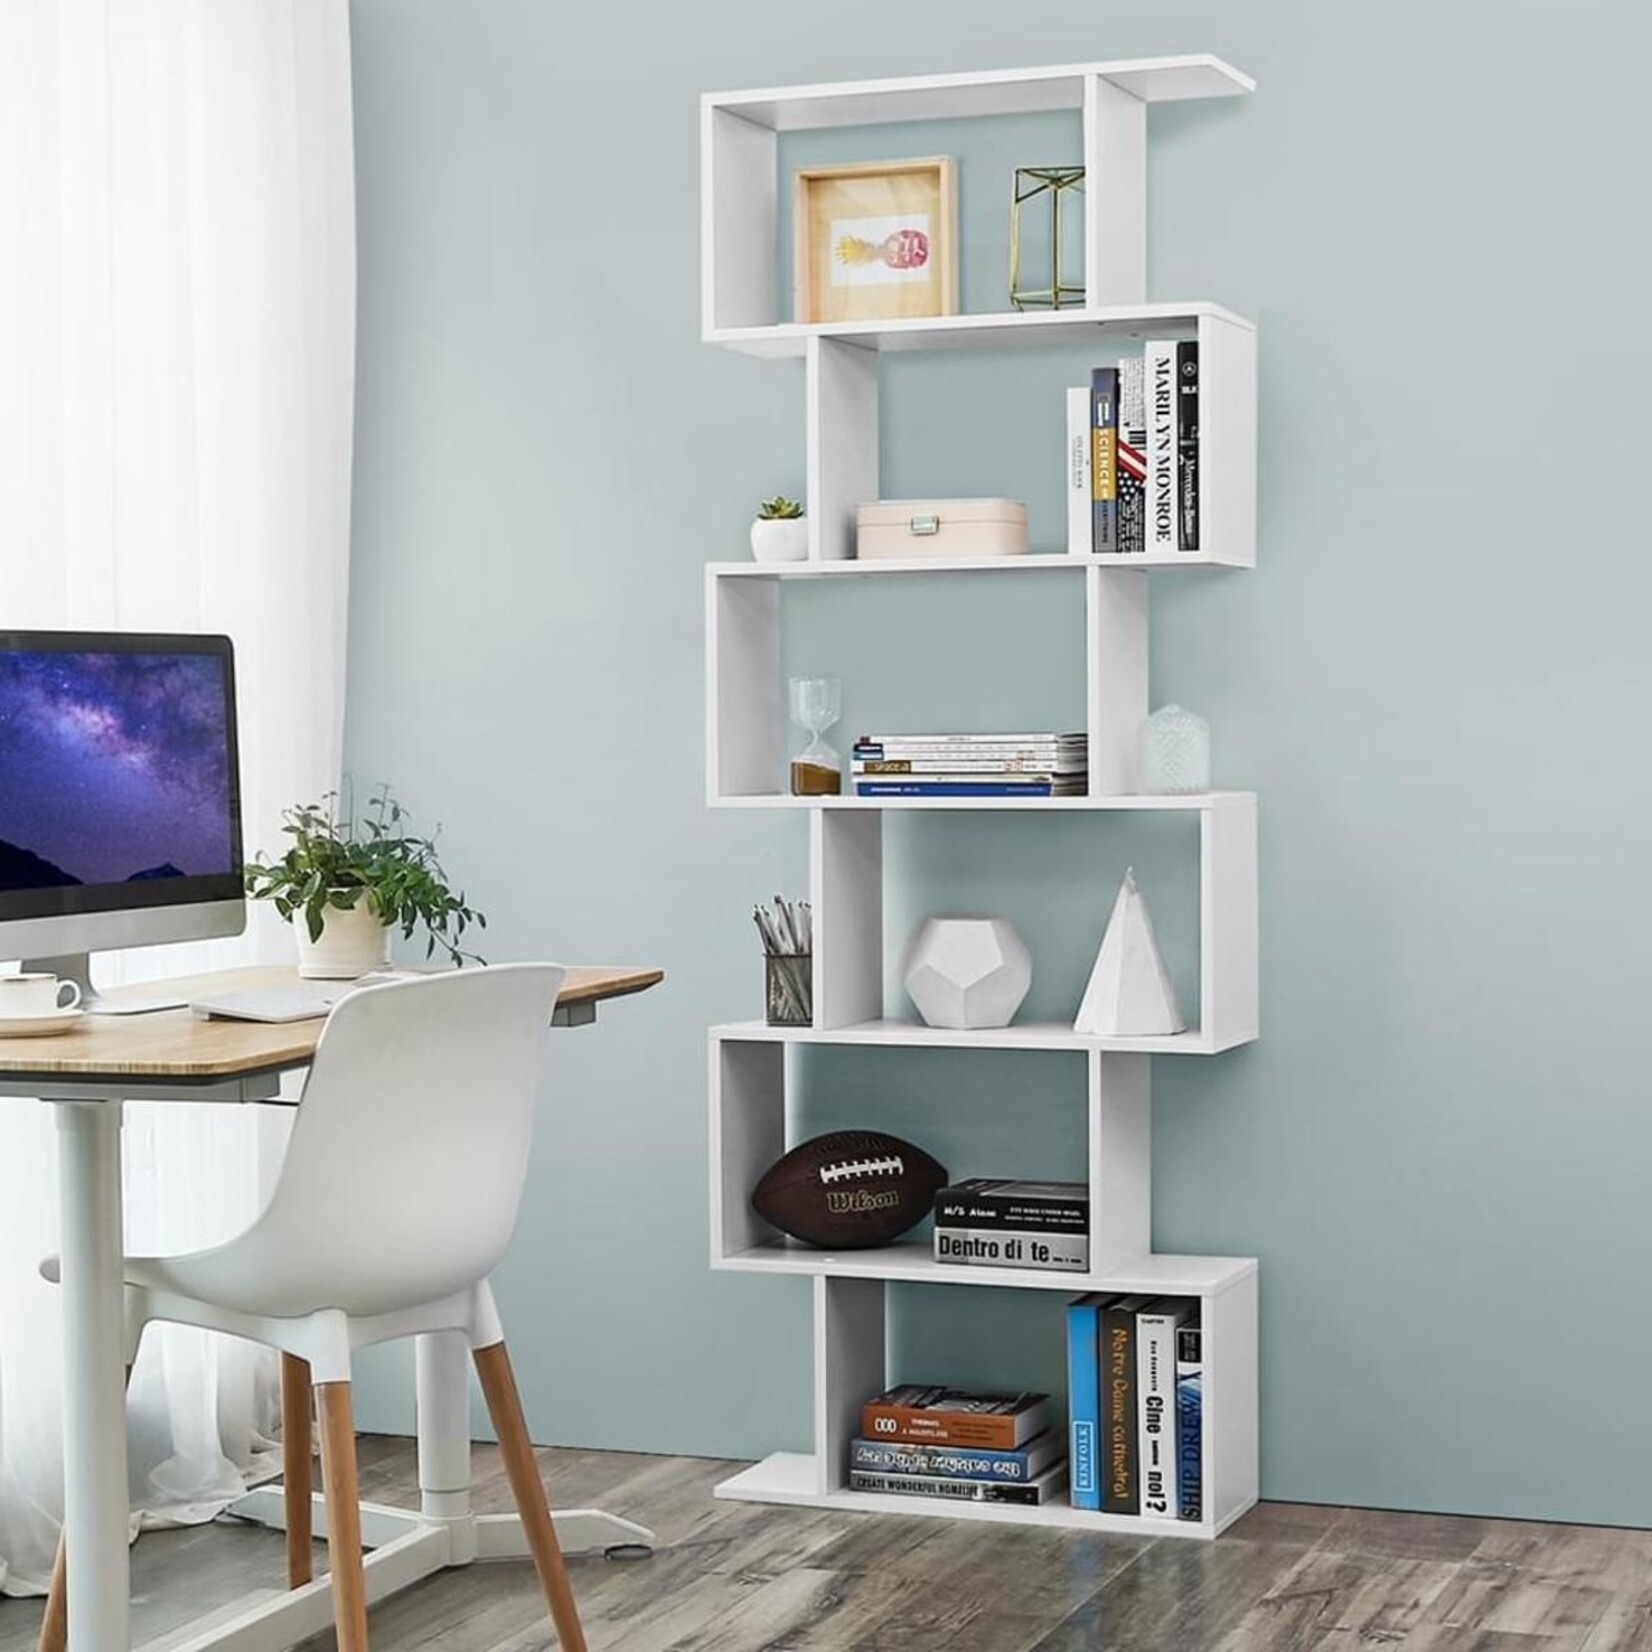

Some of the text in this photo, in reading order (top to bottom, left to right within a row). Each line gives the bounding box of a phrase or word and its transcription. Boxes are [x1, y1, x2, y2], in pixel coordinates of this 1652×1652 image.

[1099, 429, 1109, 490] SCIENCE
[1155, 357, 1172, 543] MARILYN MONROE
[827, 1189, 900, 1213] Wilson
[938, 1235, 999, 1259] Dentro
[1005, 1239, 1022, 1260] di
[1031, 1242, 1049, 1263] te
[1111, 1328, 1127, 1376] Notre
[1112, 1378, 1129, 1422] Dame
[1078, 1427, 1089, 1487] KINFOLK
[887, 1479, 937, 1494] WONDERFUL
[1181, 1468, 1201, 1520] SHIP
